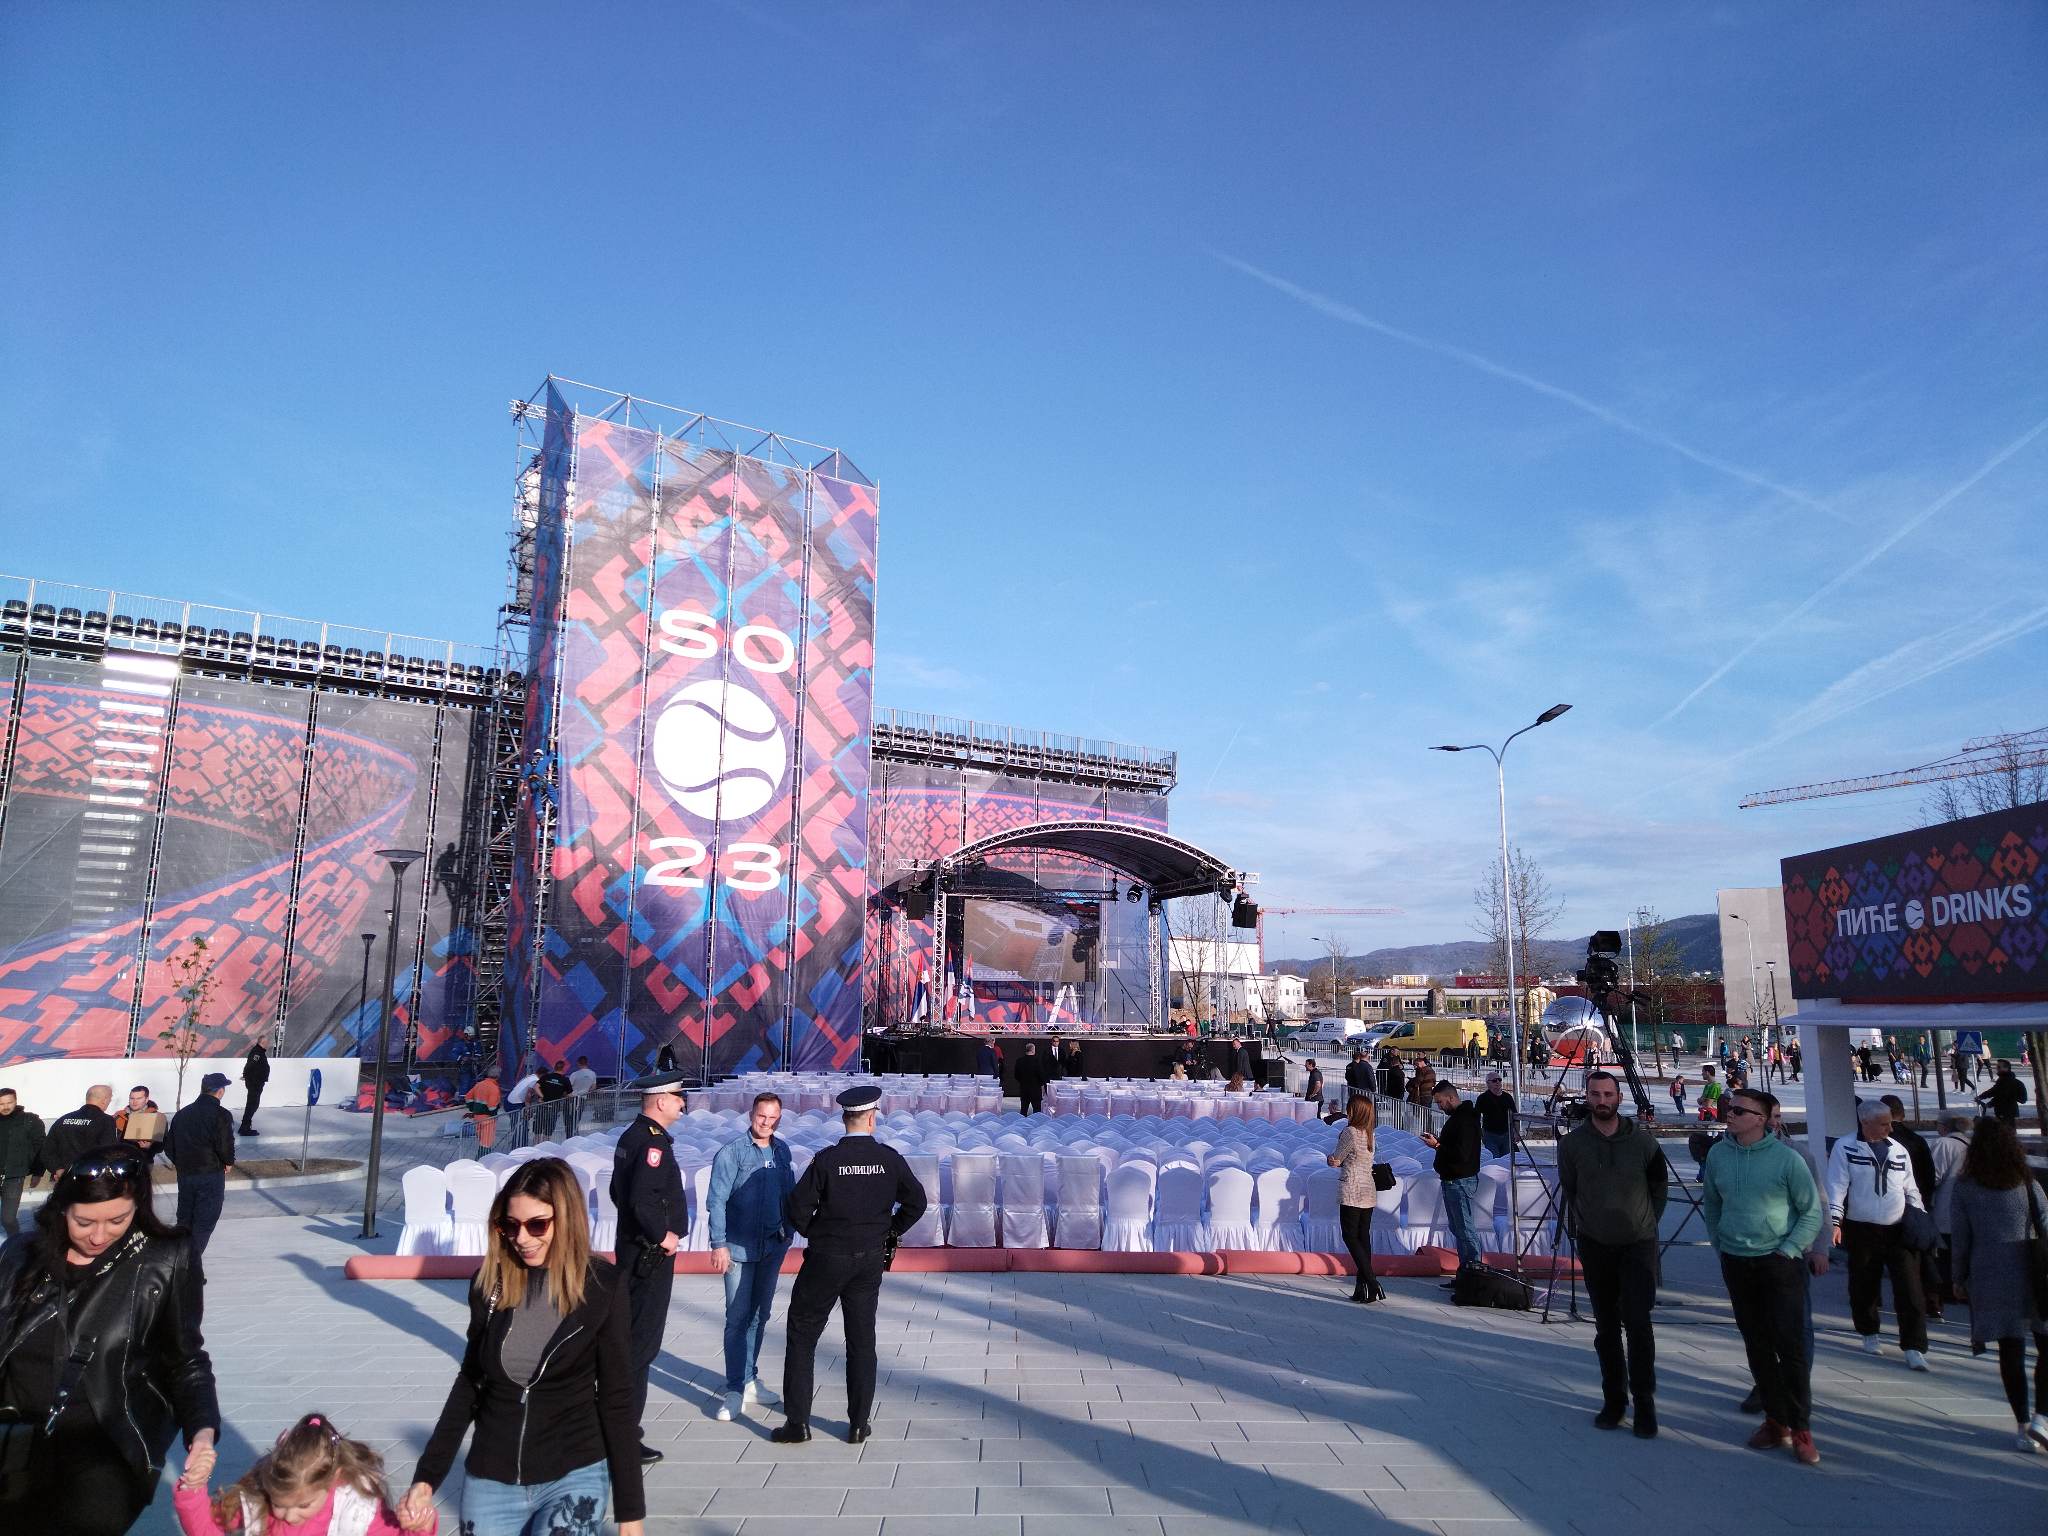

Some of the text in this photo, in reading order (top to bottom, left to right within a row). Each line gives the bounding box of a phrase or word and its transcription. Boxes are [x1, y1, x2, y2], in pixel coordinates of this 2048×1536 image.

[659, 609, 795, 674] SO
[643, 836, 782, 892] 23
[1836, 902, 1899, 937] ПИЋЕ
[1931, 883, 2033, 927] DRINKS
[62, 1118, 92, 1126] SECURITY
[838, 1164, 886, 1176] ПОЛИЦИЈА
